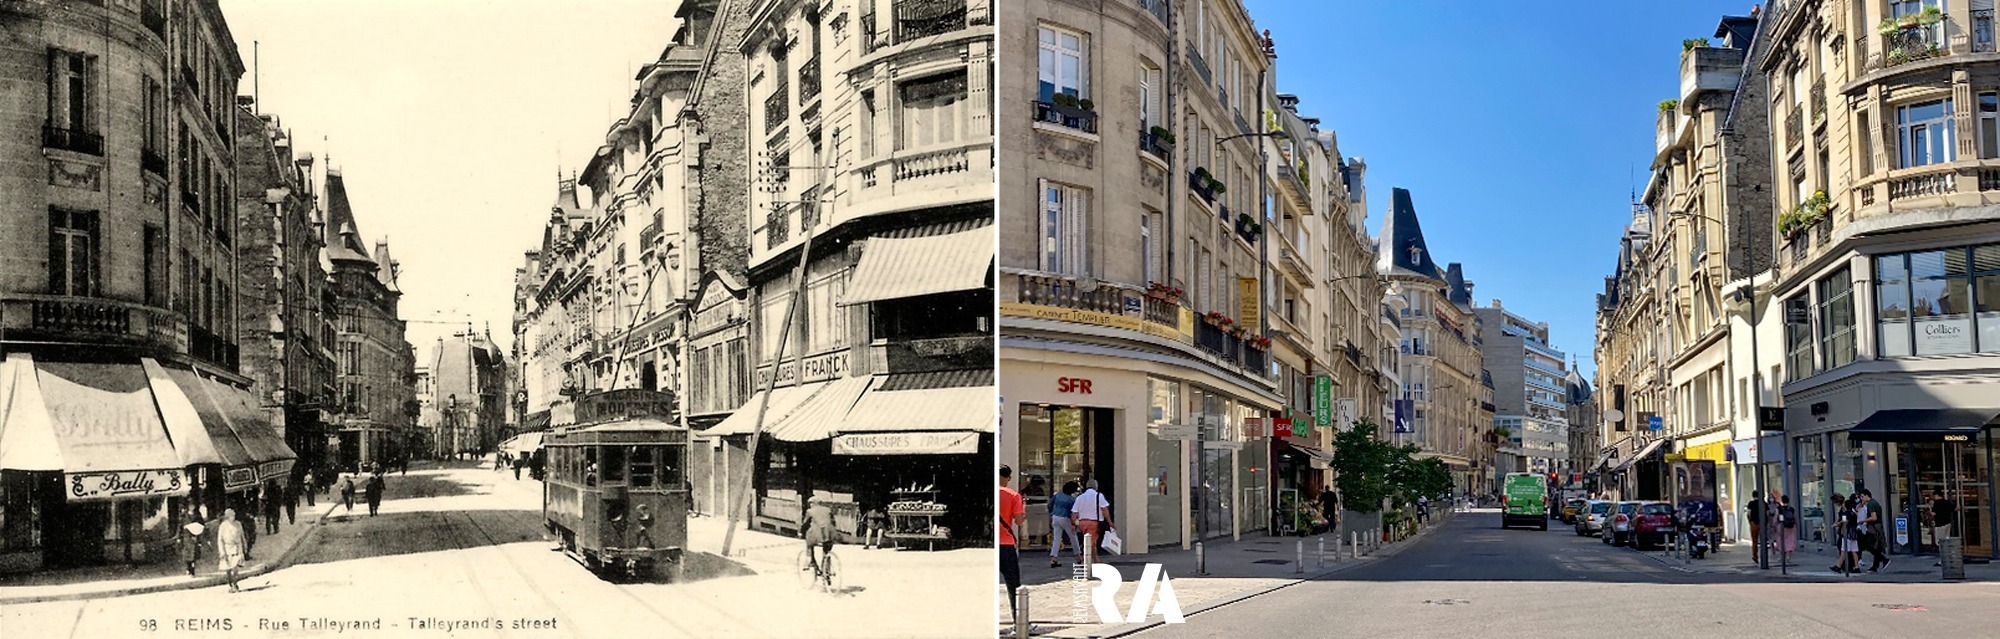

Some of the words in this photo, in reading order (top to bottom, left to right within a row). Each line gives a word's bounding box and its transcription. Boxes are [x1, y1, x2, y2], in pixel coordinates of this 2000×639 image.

[1925, 323, 1961, 335] Colliers
[804, 353, 850, 377] FRANCK
[1058, 376, 1092, 395] SFR
[1319, 377, 1329, 425] FLEURS
[1276, 423, 1293, 432] SFR
[101, 472, 155, 495] Bally
